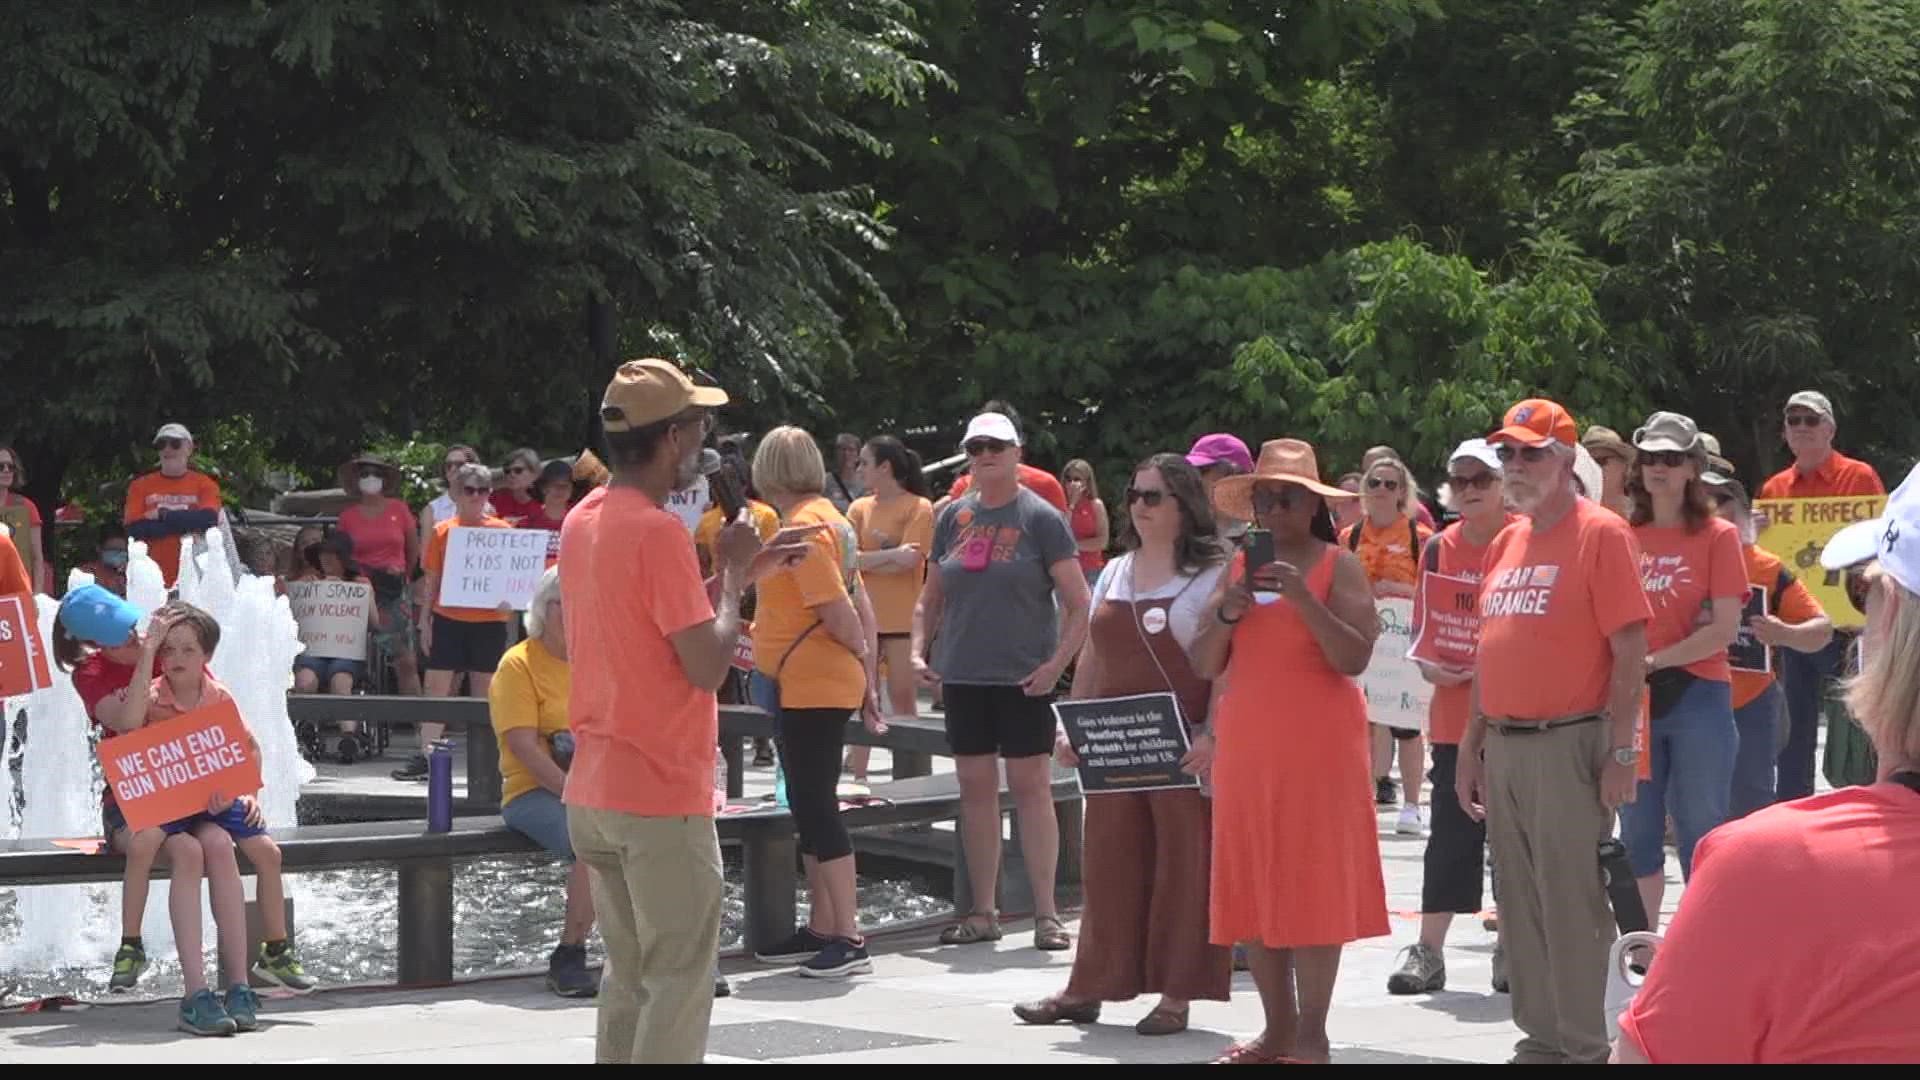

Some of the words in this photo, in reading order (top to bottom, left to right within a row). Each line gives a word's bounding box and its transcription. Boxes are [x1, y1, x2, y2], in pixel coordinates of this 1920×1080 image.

[1759, 503, 1795, 525] THE
[1801, 501, 1878, 523] PERFECT
[466, 531, 540, 549] PROTECT
[464, 553, 502, 570] KIDS
[510, 555, 540, 571] NOT
[326, 583, 367, 598] STAND
[462, 576, 492, 593] THE
[1482, 588, 1551, 617] ORANGE
[115, 752, 147, 778] WE
[147, 739, 186, 769] CAN
[186, 725, 226, 755] END
[1078, 743, 1089, 754] of
[1091, 742, 1123, 754] death
[117, 775, 156, 801] GUN
[156, 742, 247, 789] VIOLENCE
